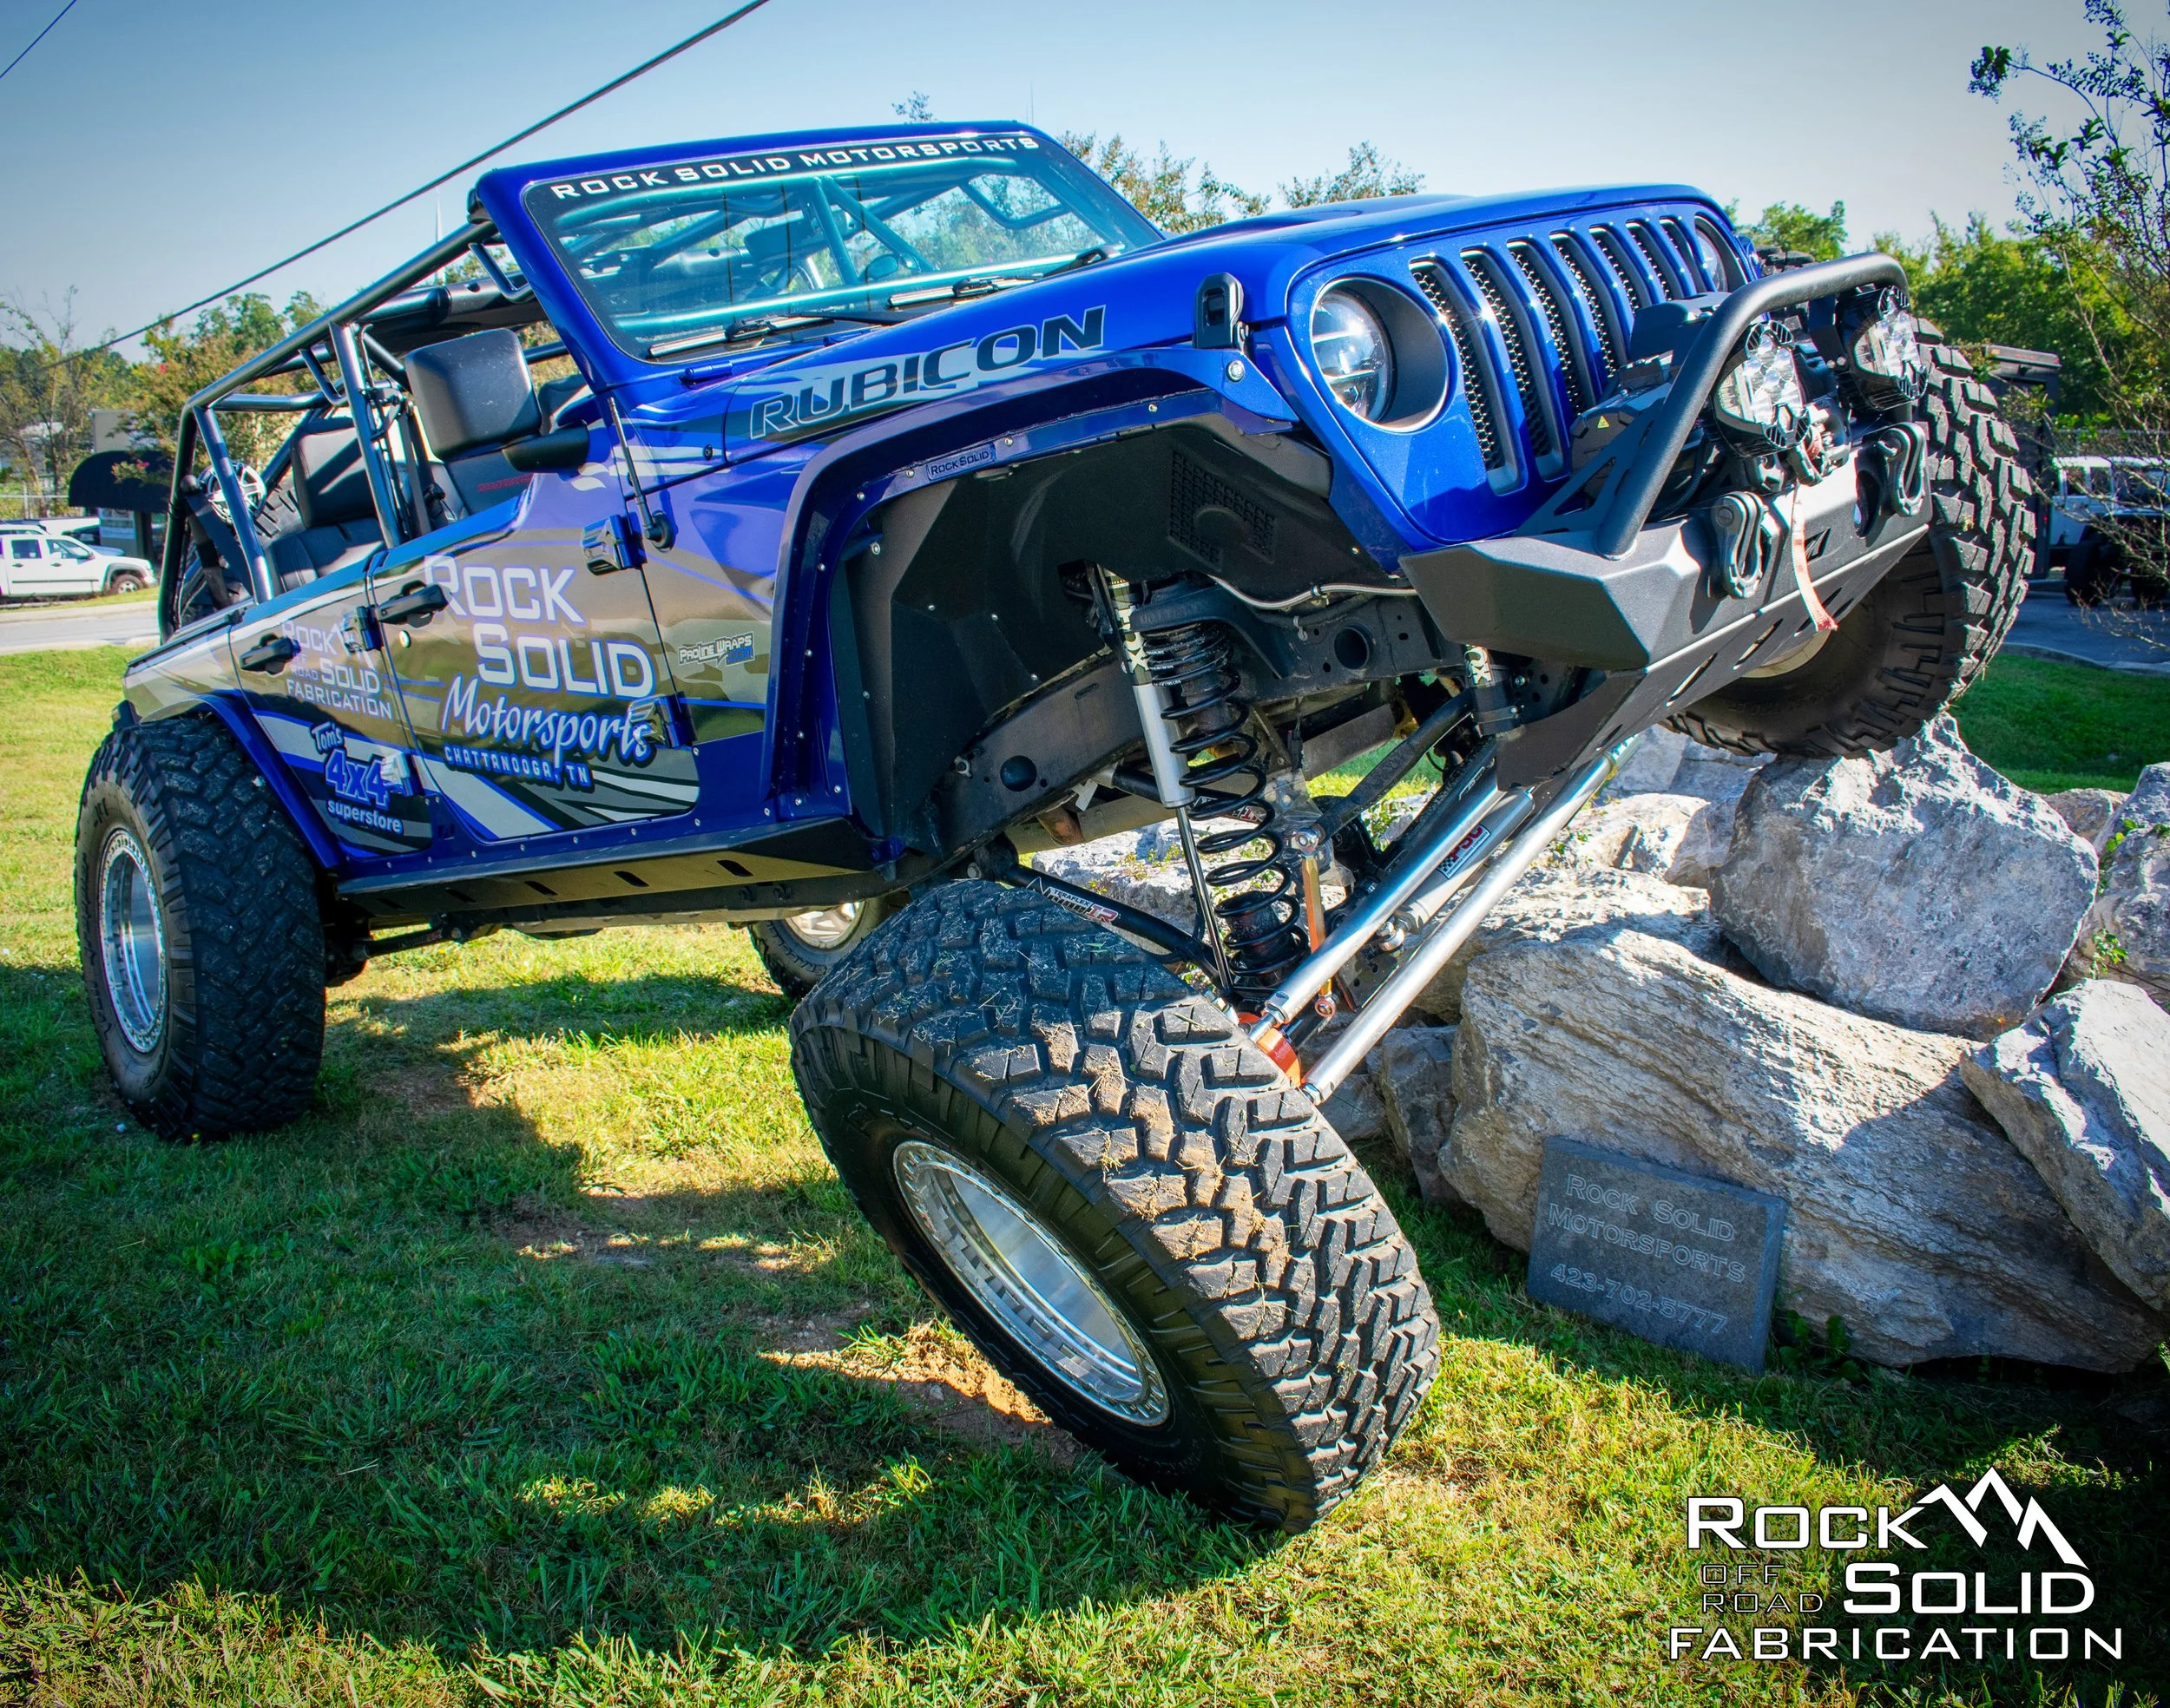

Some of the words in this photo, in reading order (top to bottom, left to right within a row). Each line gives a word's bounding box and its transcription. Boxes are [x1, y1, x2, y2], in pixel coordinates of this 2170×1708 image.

[550, 171, 669, 200] ROCK
[674, 157, 792, 182] SOLID
[799, 137, 1040, 167] MOTORSPORTS
[750, 304, 1107, 440] RUBICON
[930, 459, 958, 476] ROCK
[959, 450, 990, 466] SOLID
[424, 555, 584, 623] ROCK
[319, 657, 381, 694] SOLID
[473, 622, 654, 699] SOLID
[286, 679, 394, 721] FABRICATION
[441, 675, 651, 769] Motorsports
[311, 721, 343, 752] Tom's
[565, 763, 589, 785] TN
[327, 799, 403, 833] superstore
[1565, 1173, 1639, 1215] ROCK
[1654, 1199, 1735, 1242] SOLID
[1548, 1203, 1746, 1283] MOTORSPORTS
[1550, 1263, 1728, 1334] 423-702-5777
